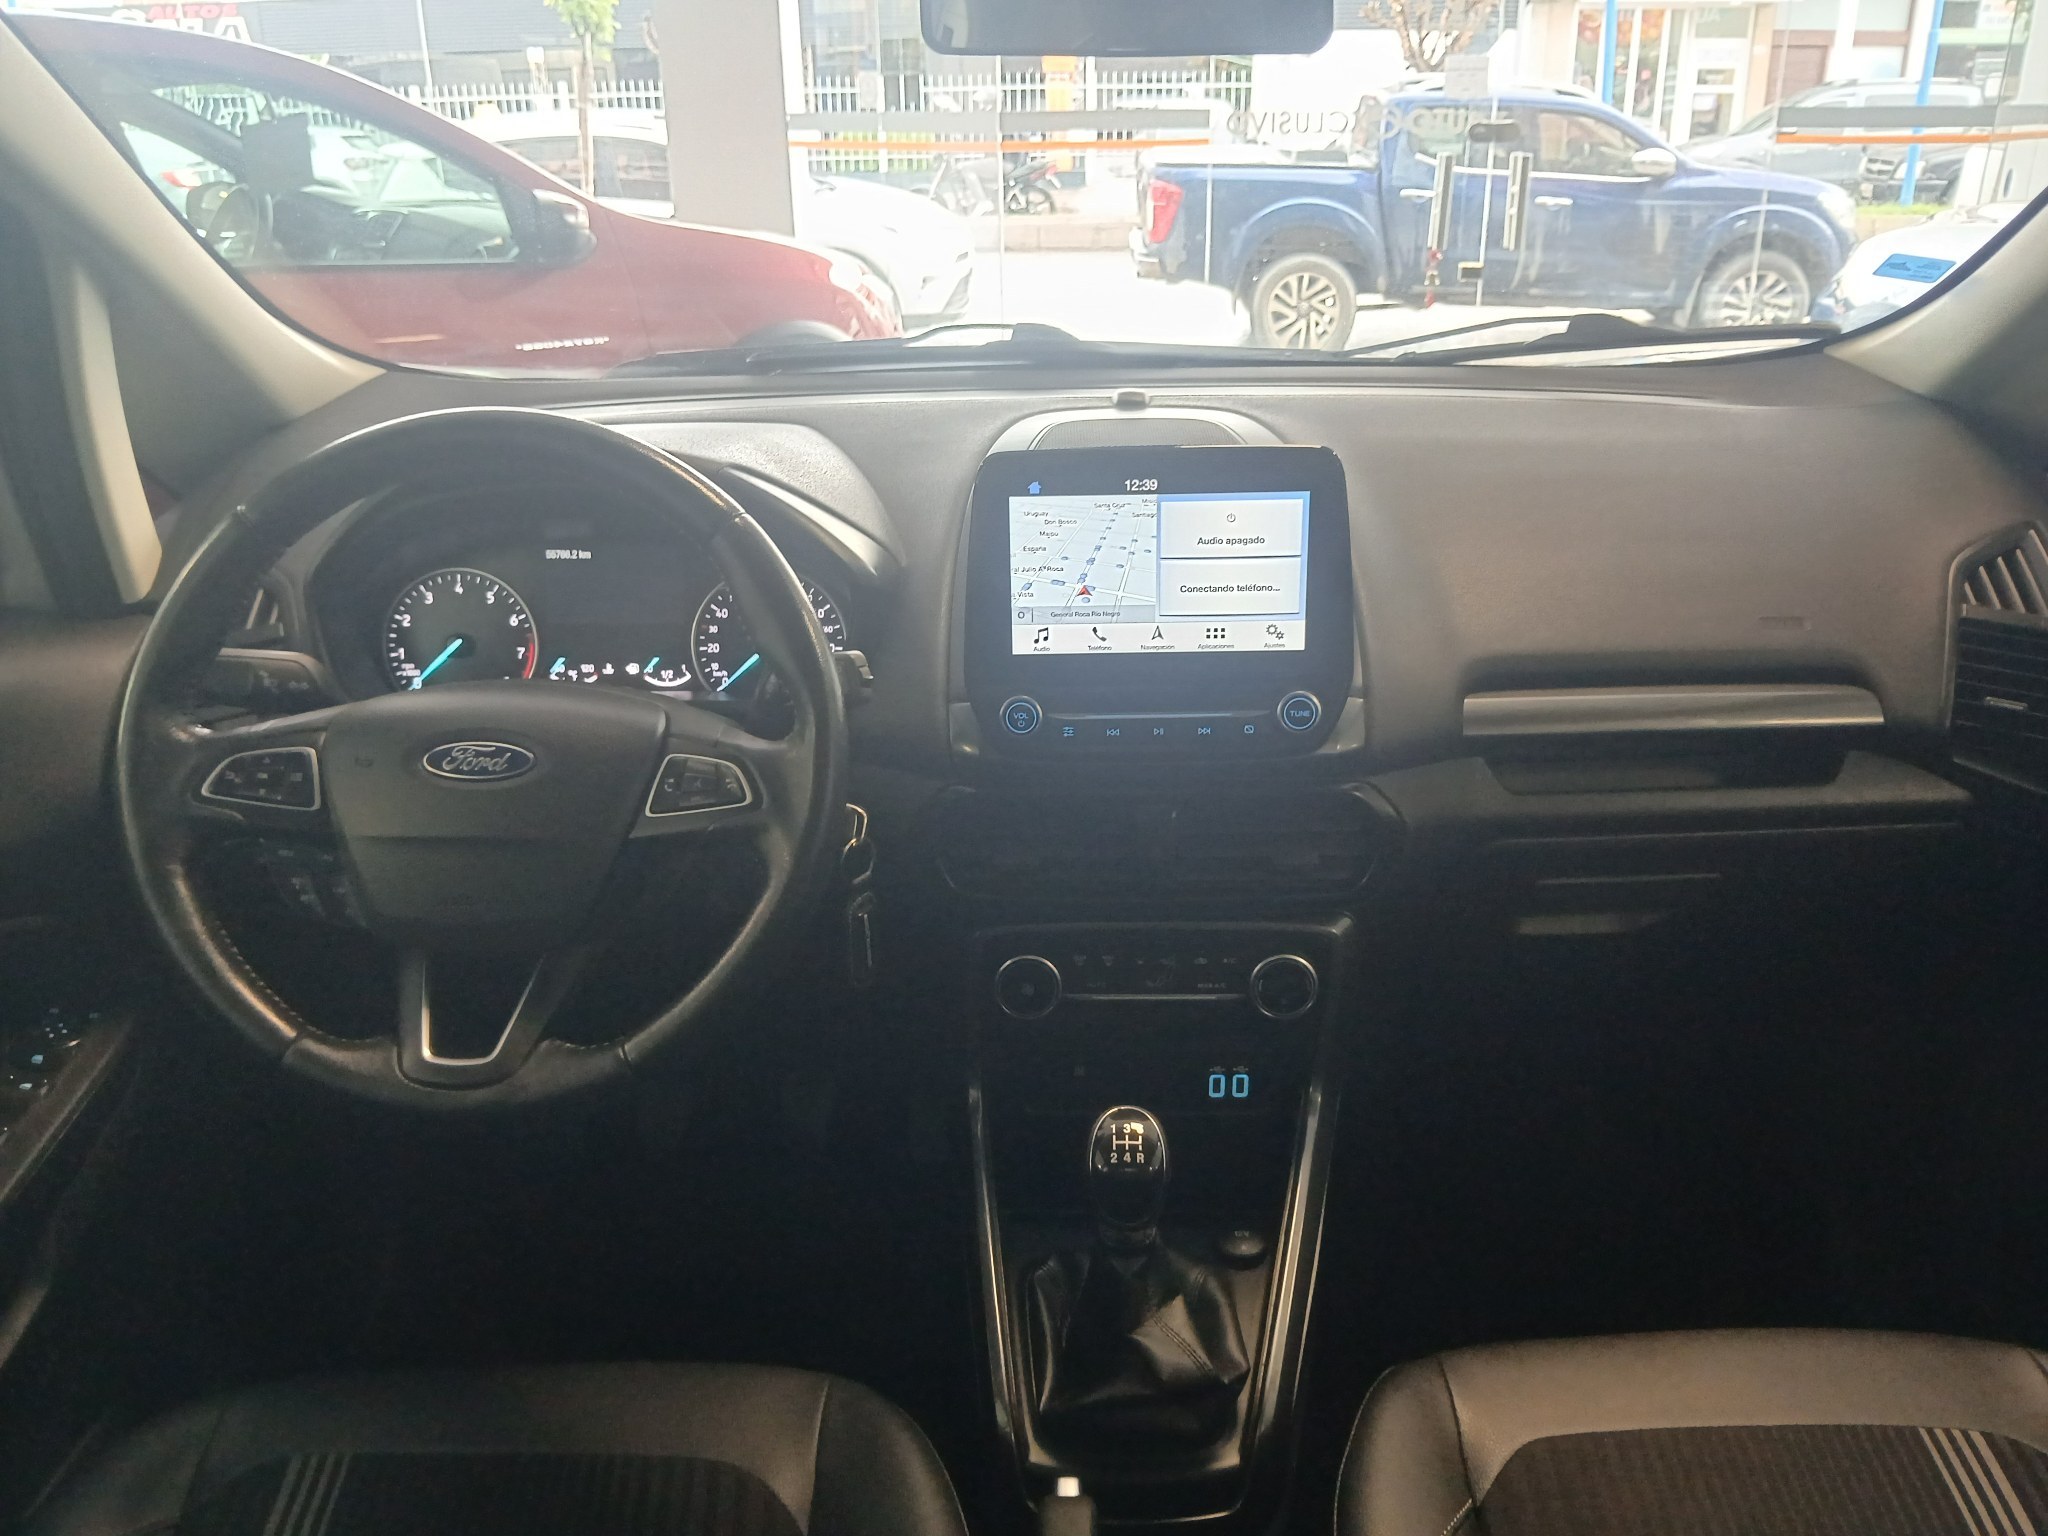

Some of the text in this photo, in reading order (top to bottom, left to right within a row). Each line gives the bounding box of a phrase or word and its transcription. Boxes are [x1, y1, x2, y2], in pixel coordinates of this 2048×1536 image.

[1124, 479, 1158, 491] 12:39
[1197, 536, 1266, 546] Audio apagado
[454, 583, 464, 595] 4
[1180, 583, 1281, 594] Conectando teléfono...
[424, 592, 434, 604] 3
[485, 592, 495, 605] 5
[715, 608, 729, 619] 40
[402, 614, 411, 627] 2
[509, 614, 519, 627] 6
[708, 625, 719, 634] 30
[516, 647, 526, 660] 7
[707, 643, 720, 654] 20
[442, 745, 512, 771] Ford
[1110, 1123, 1116, 1134] 1
[1123, 1123, 1131, 1134] 3
[1110, 1151, 1145, 1164] 2 4 R
